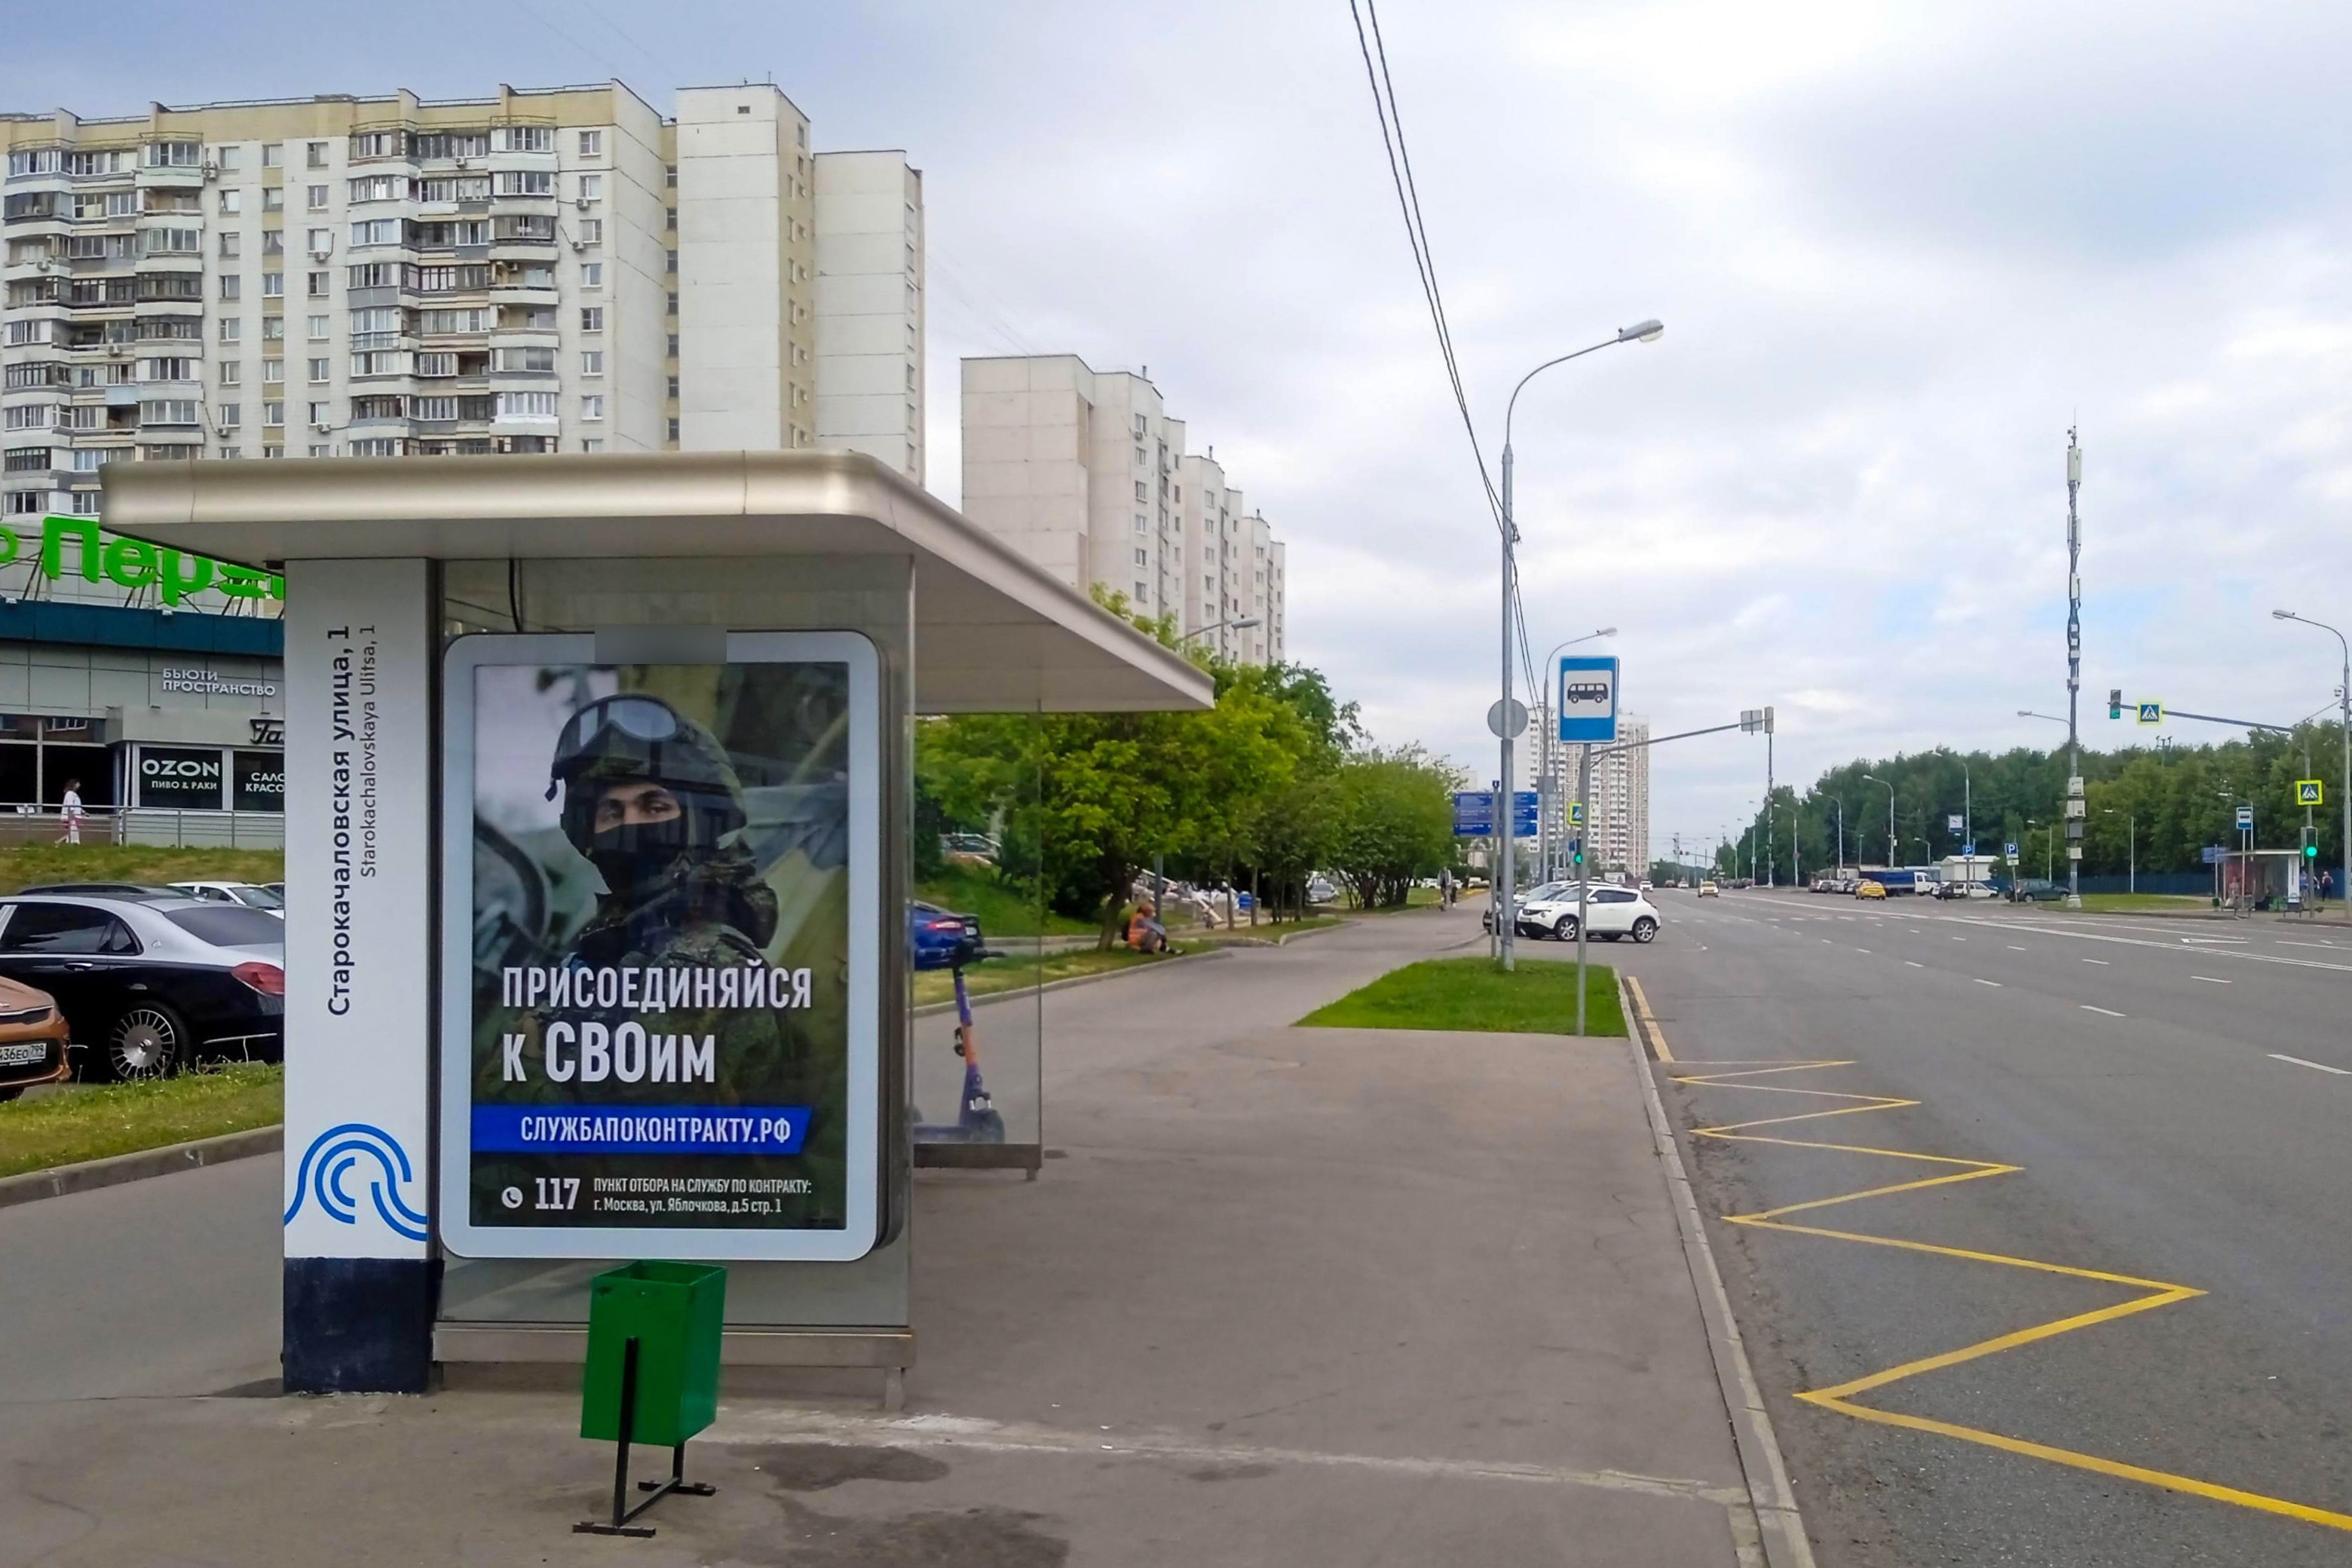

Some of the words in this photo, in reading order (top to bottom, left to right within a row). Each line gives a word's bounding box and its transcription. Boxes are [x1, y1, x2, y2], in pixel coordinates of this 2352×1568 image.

[327, 626, 349, 639] 1
[360, 625, 375, 634] 1
[163, 668, 218, 681] БЬЮТИ
[360, 641, 378, 695] Ulitsa,
[163, 680, 276, 697] ПРОСТРАНСТВО
[333, 648, 355, 741] улица,
[142, 759, 219, 777] OZON
[152, 780, 179, 789] ПИВО
[182, 781, 188, 789] &
[191, 781, 217, 790] РАКИ
[360, 701, 379, 877] Starokachalovskaya
[2008, 844, 2015, 853] P
[327, 751, 355, 1016] Старокачаловская
[502, 958, 812, 1012] ПРИСОЕДИНЯЙСЯ
[521, 1116, 791, 1144] СЛУЖБАПОКОНТРАКТУ.РФ
[534, 1178, 580, 1210] 117
[594, 1178, 627, 1193] ПУНКТ
[629, 1178, 669, 1193] ОТБОРА
[671, 1179, 684, 1193] НА
[687, 1179, 730, 1193] СЛУЖБУ
[732, 1179, 746, 1193] ПО
[749, 1179, 812, 1193] КОНТРАКТУ:
[594, 1200, 602, 1211] г.
[604, 1198, 647, 1213] Москва,
[650, 1200, 666, 1214] ул.
[668, 1198, 730, 1213] Яблочкова,
[751, 1202, 773, 1215] стр.
[775, 1199, 782, 1212] 1
